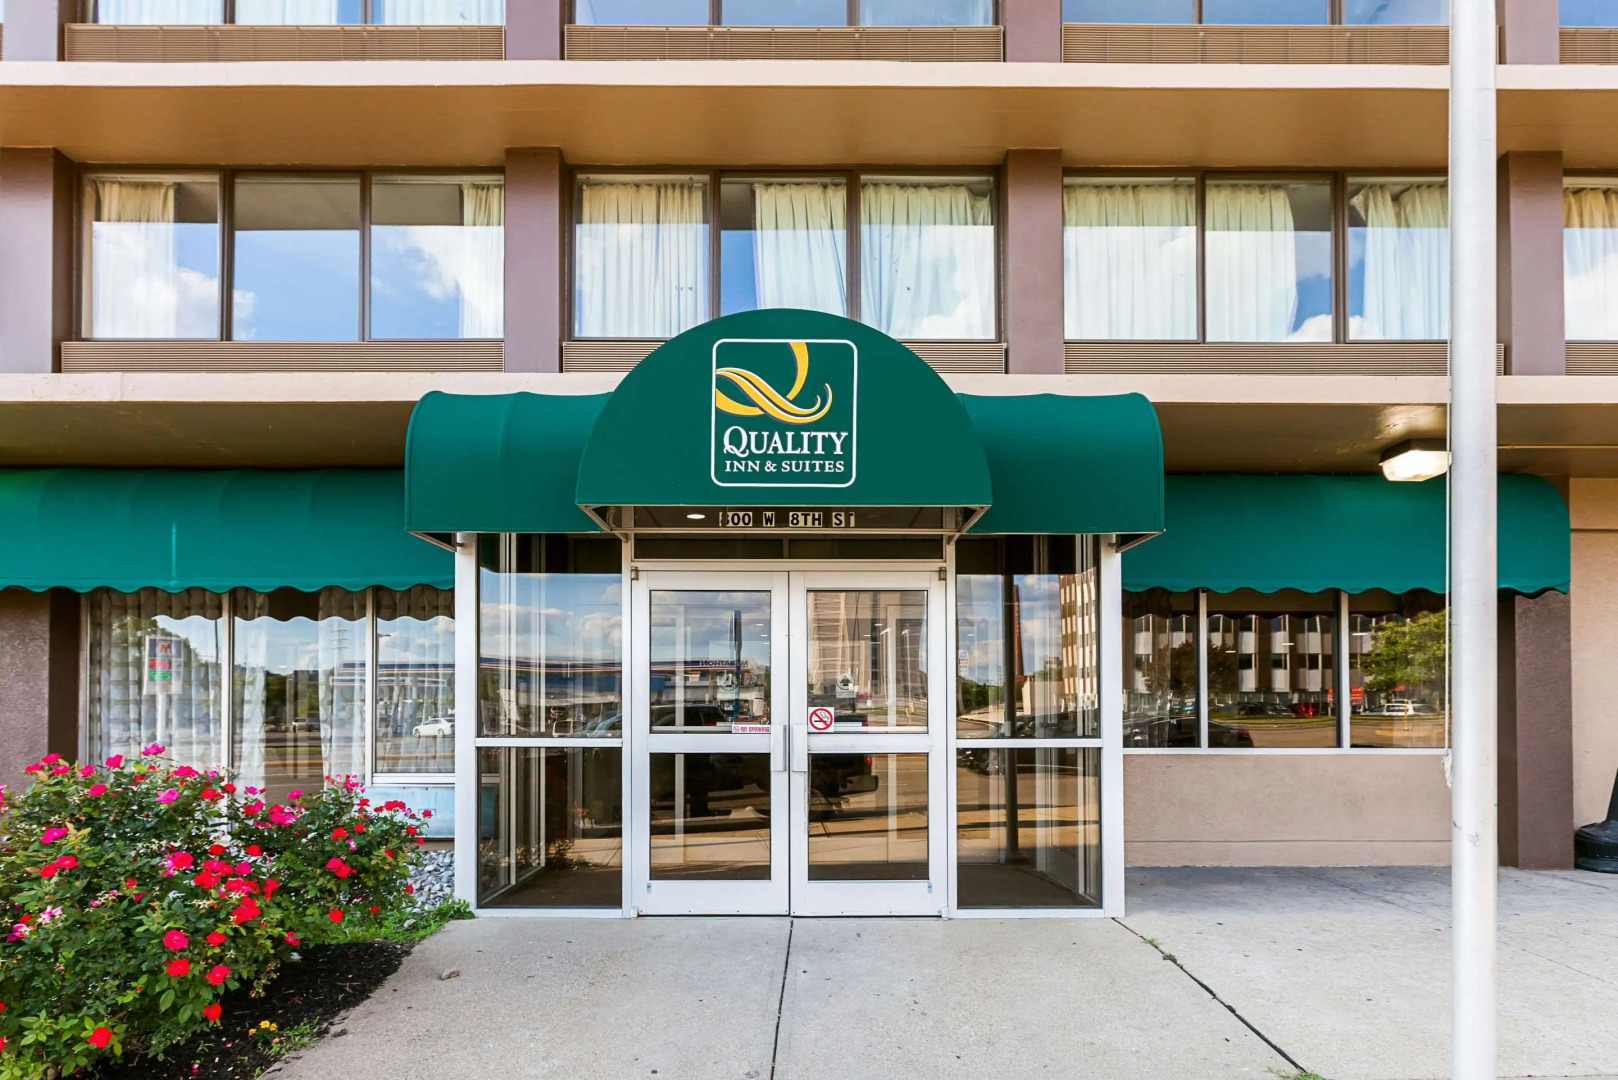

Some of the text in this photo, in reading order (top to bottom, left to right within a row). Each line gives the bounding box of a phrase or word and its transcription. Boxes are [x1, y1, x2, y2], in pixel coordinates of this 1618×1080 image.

[723, 426, 848, 457] QUALITY
[725, 460, 844, 473] INN & SUITES
[763, 512, 774, 526] W
[790, 512, 822, 526] 8TH
